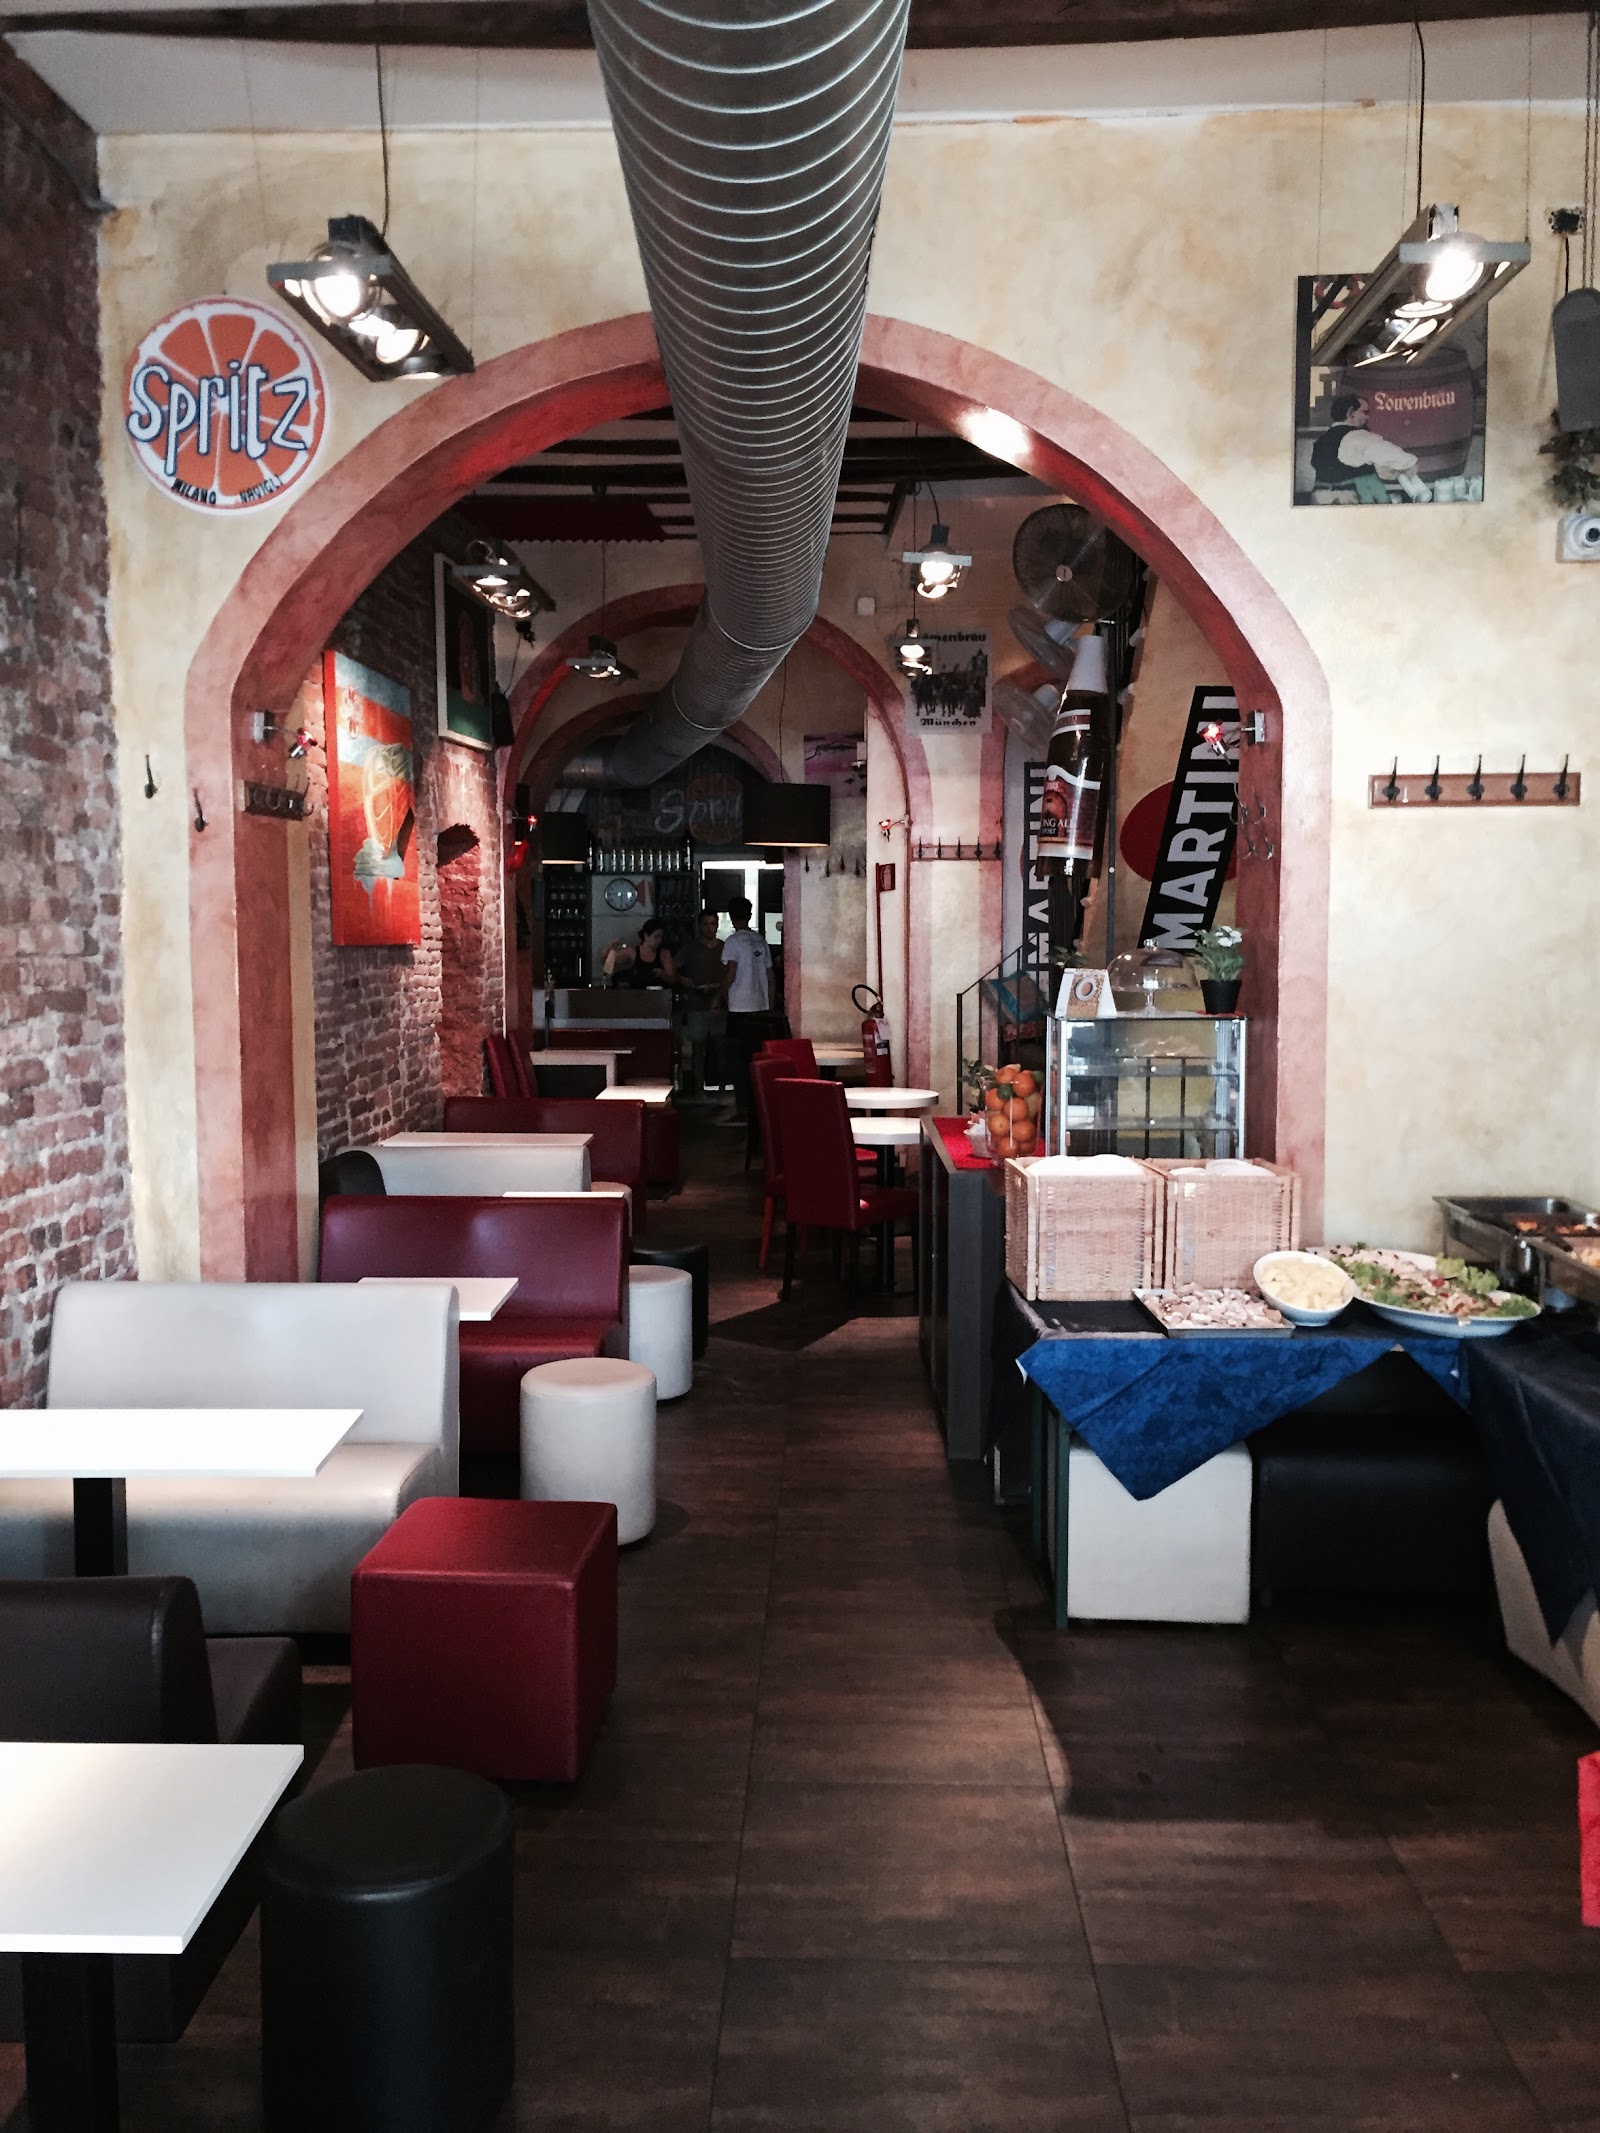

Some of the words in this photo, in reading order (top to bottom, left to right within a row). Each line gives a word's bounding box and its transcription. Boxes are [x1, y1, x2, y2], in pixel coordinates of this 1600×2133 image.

[126, 359, 309, 476] Spritz
[171, 478, 217, 504] MILANO
[239, 474, 284, 503] NAVIGLI
[1151, 695, 1239, 949] MARTINI
